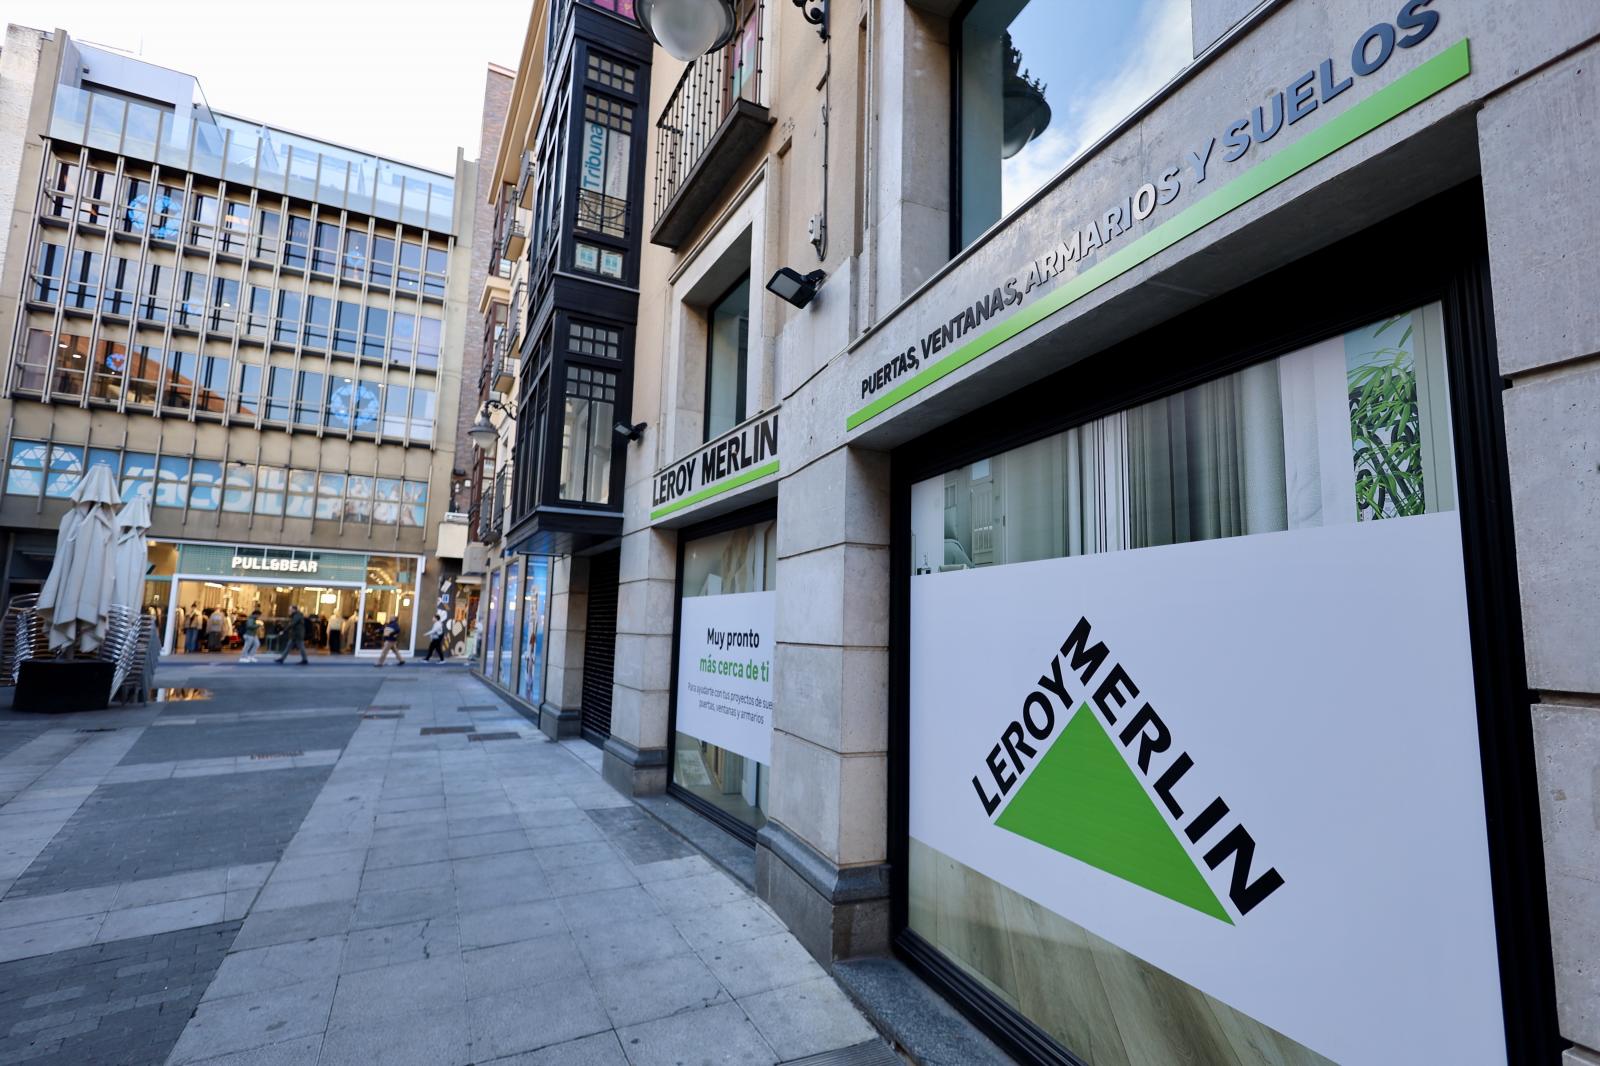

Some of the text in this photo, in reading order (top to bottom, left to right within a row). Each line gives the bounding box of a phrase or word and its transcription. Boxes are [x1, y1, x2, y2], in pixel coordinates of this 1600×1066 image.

[584, 124, 604, 188] Tribuna
[862, 0, 1440, 399] PUERTAS, VENTANAS, ARMARIOS Y SUELOS
[653, 414, 779, 507] LEROY MERLIN
[231, 556, 318, 573] PULL&BEAR
[700, 654, 770, 682] más cerca de ti
[707, 627, 760, 651] Muy pronto
[971, 615, 1286, 917] LEROY MERLIN
